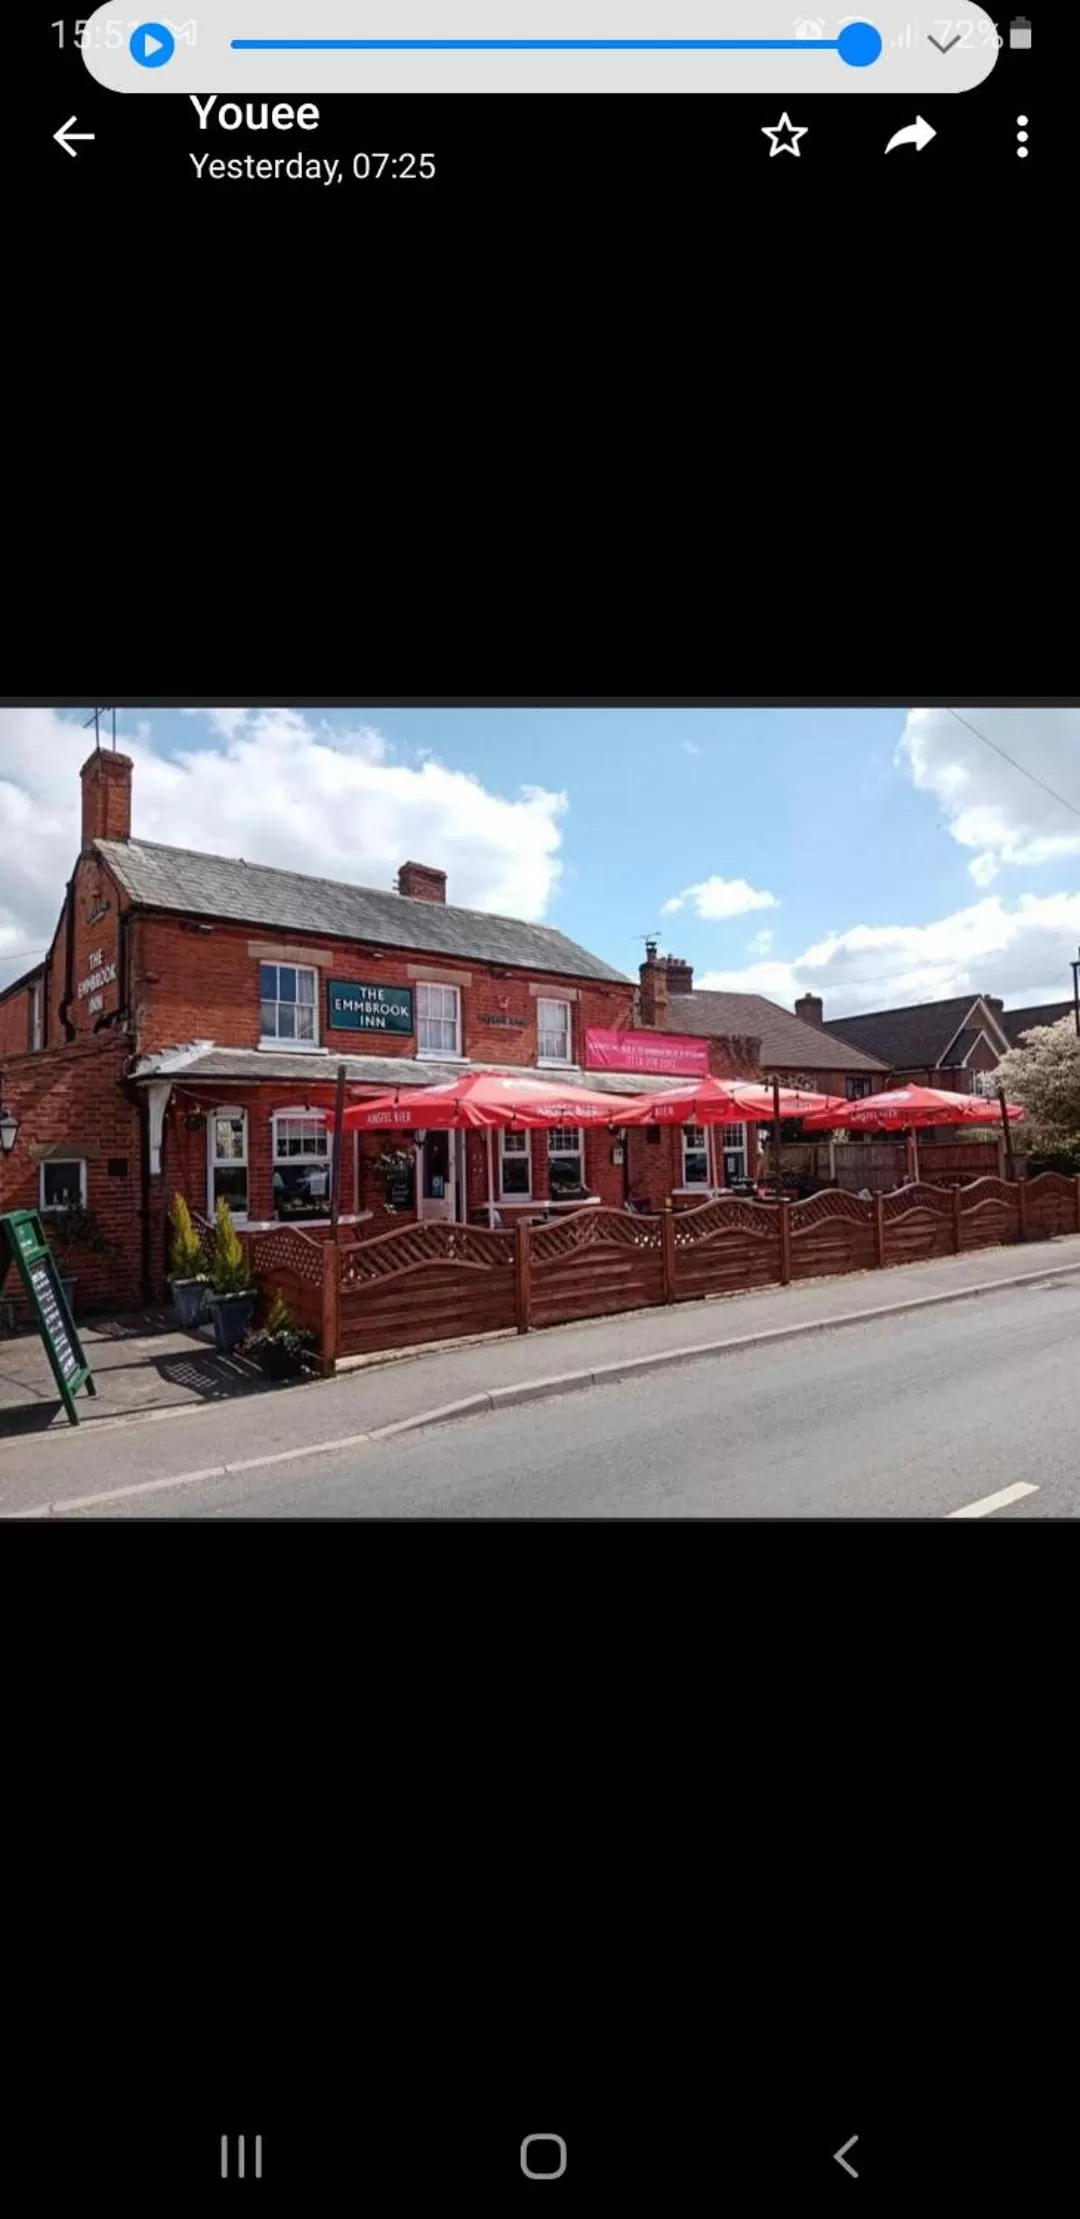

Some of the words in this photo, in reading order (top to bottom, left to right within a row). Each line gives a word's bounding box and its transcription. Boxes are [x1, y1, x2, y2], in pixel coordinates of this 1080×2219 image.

[360, 986, 386, 1001] THE
[334, 998, 410, 1017] EMMBROOK
[360, 1015, 386, 1029] INN
